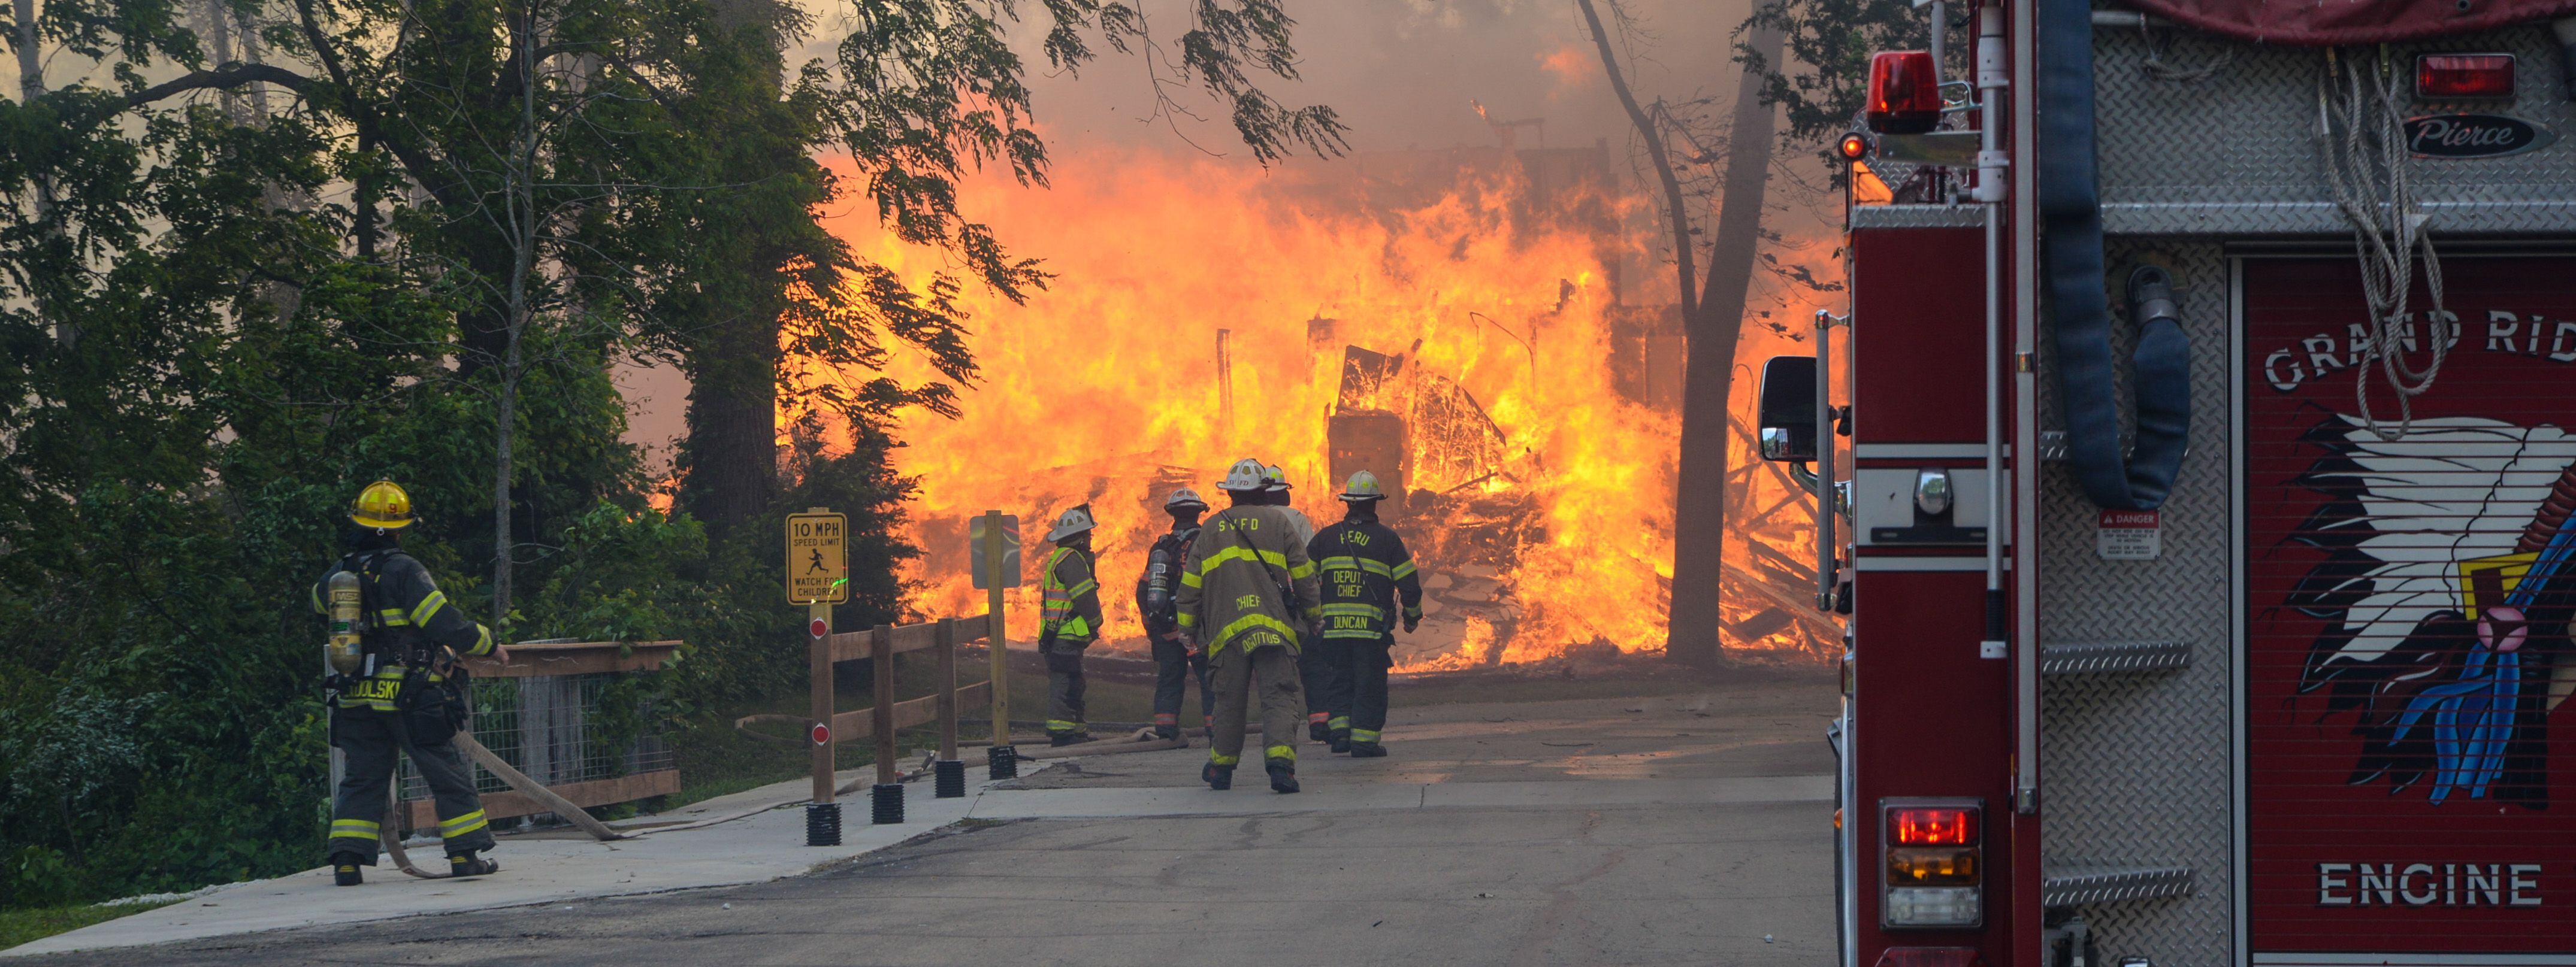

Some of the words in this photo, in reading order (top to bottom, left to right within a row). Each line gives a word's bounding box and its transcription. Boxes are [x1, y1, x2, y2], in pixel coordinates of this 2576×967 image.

[2411, 119, 2514, 151] Pierce
[2265, 311, 2461, 390] GRAND
[2486, 310, 2576, 362] RID
[389, 504, 397, 514] 9
[2117, 515, 2154, 523] DANGER
[794, 523, 811, 536] 10
[815, 523, 839, 536] MPH
[1334, 571, 1368, 585] DEPUT
[1337, 584, 1362, 597] CHIEF
[1236, 595, 1260, 611] CHIEF
[1334, 616, 1368, 629] DUNCAN
[2318, 863, 2542, 905] ENGINE
